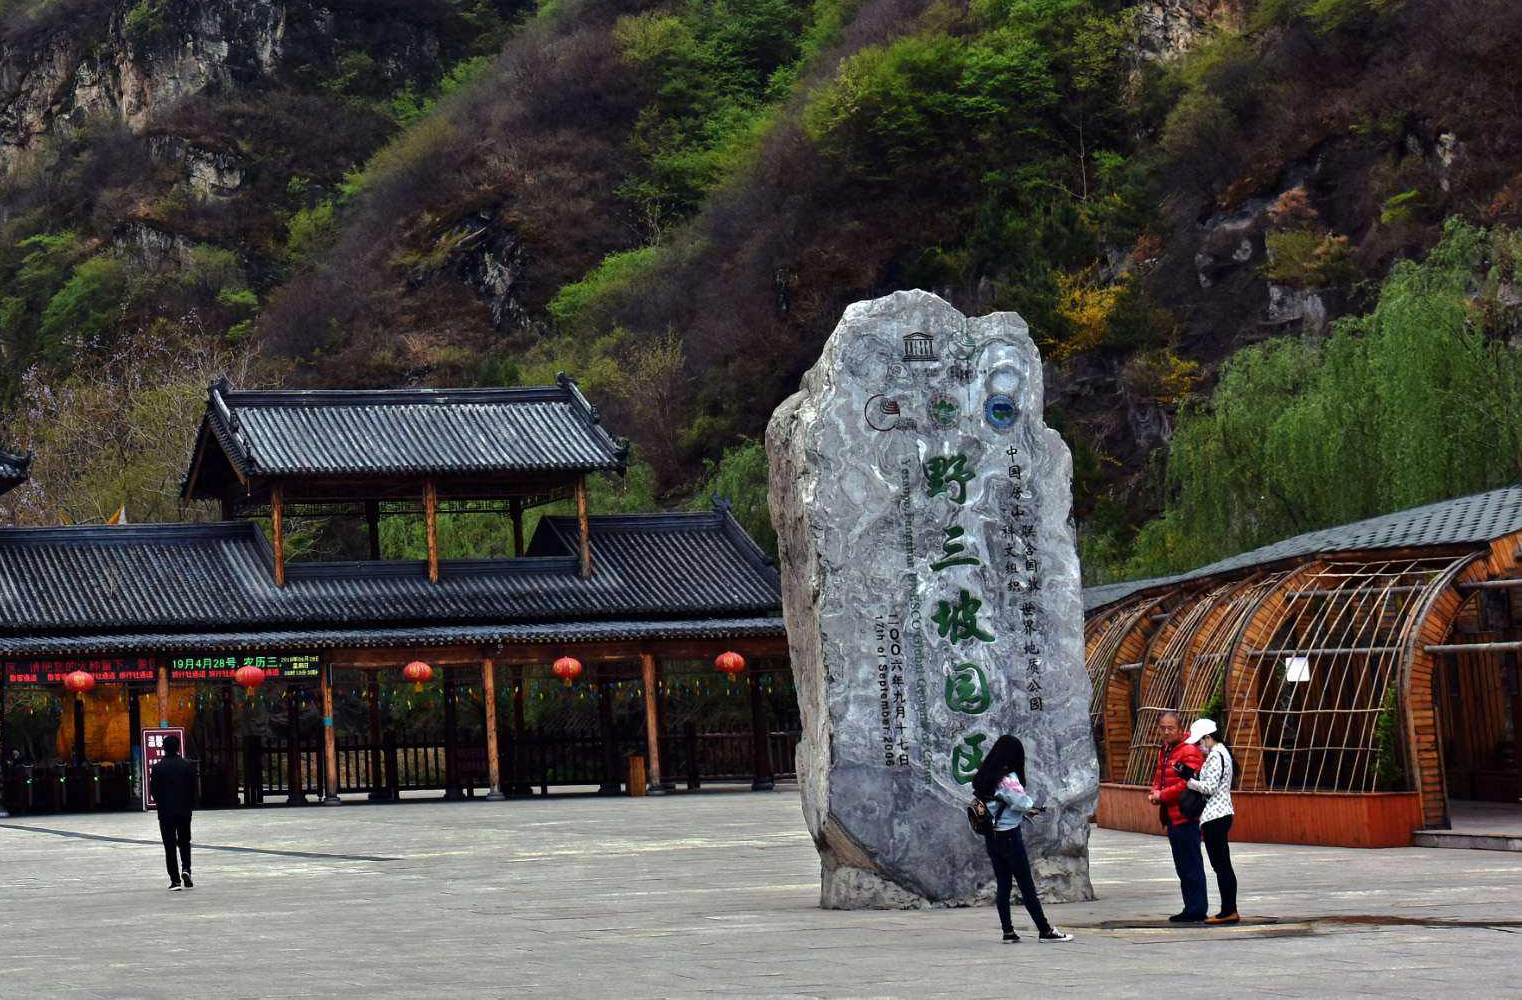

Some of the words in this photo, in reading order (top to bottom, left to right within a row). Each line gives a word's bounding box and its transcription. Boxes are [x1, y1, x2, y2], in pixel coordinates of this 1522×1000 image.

[875, 615, 884, 641] 17th
[908, 573, 921, 630] UNESCO
[922, 454, 996, 785] 野三坡园区
[878, 664, 891, 730] September
[883, 737, 895, 767] 2006
